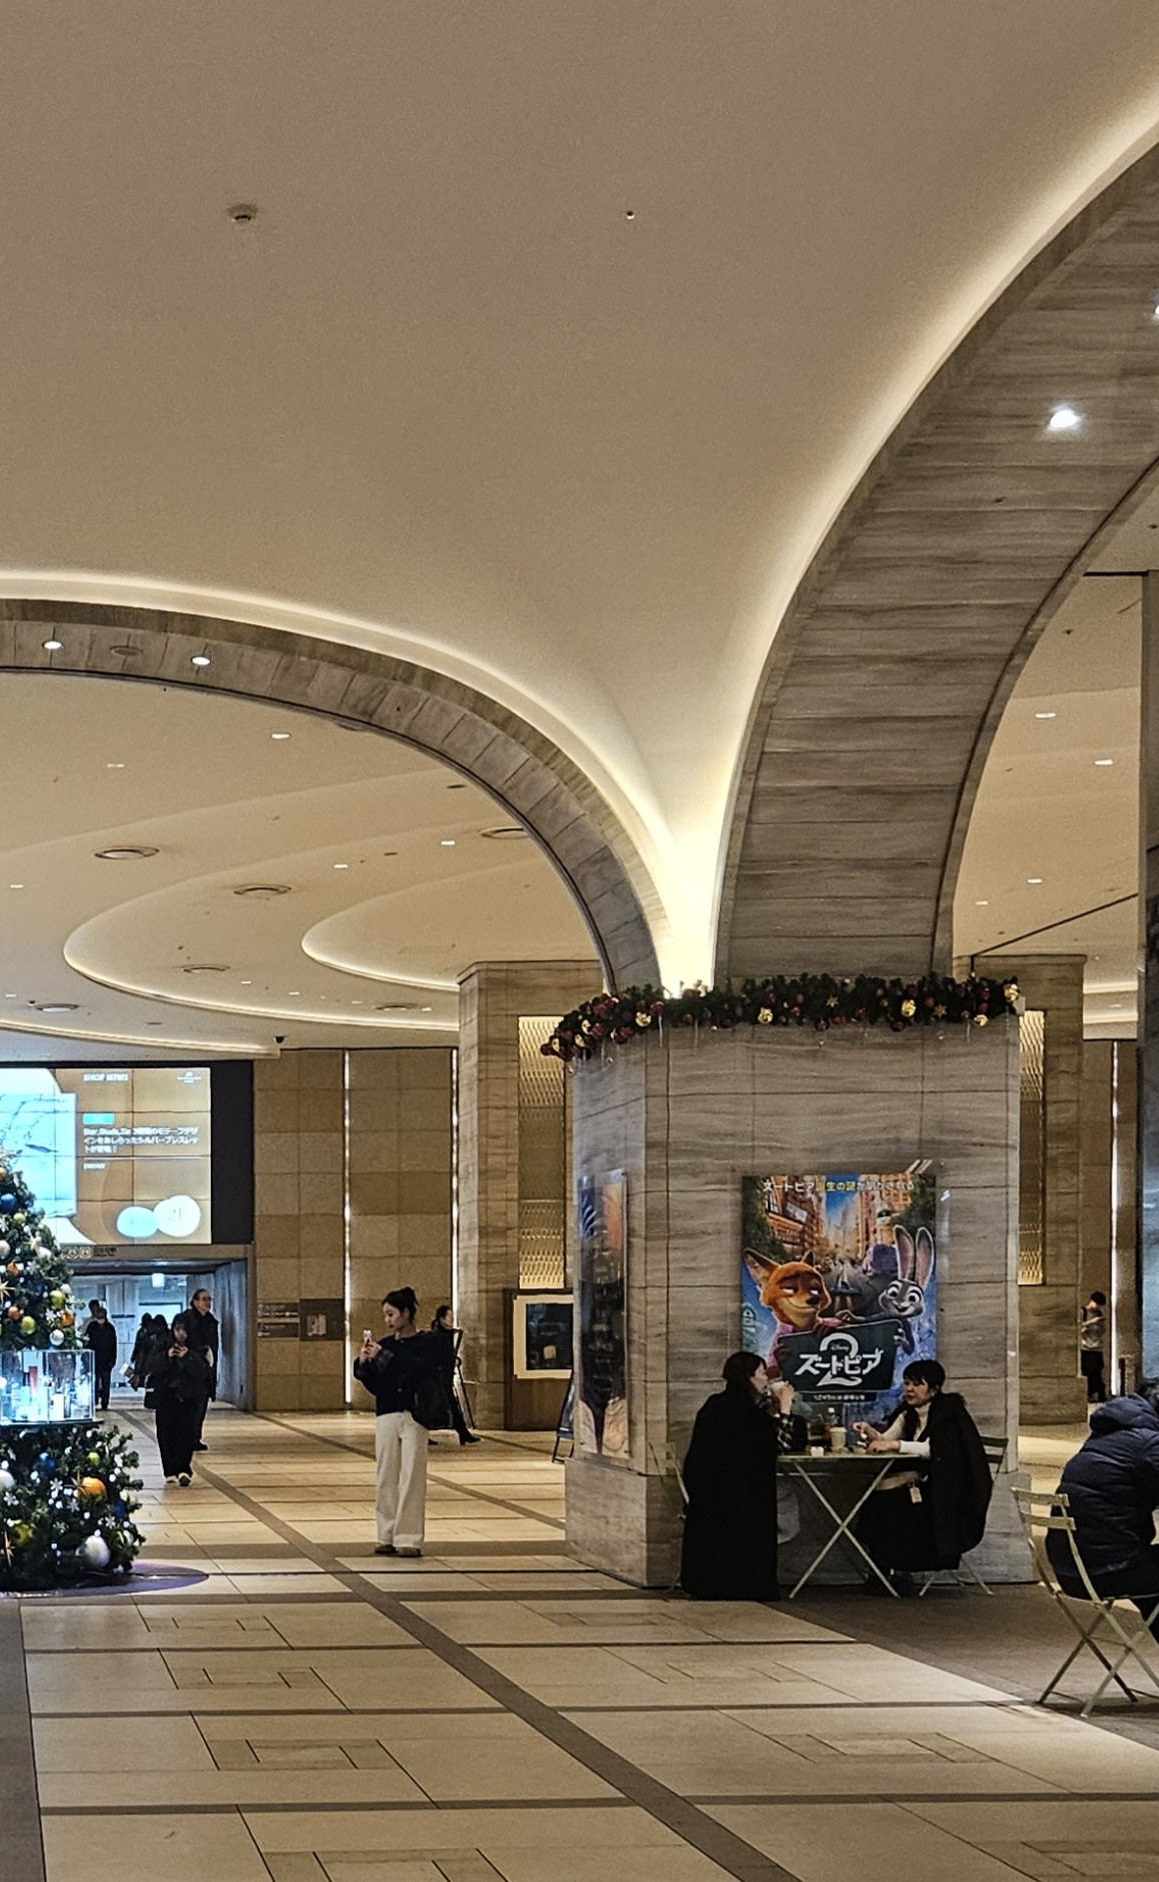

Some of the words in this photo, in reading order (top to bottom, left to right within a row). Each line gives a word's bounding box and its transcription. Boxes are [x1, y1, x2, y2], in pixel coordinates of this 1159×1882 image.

[794, 1347, 884, 1376] ズートピア
